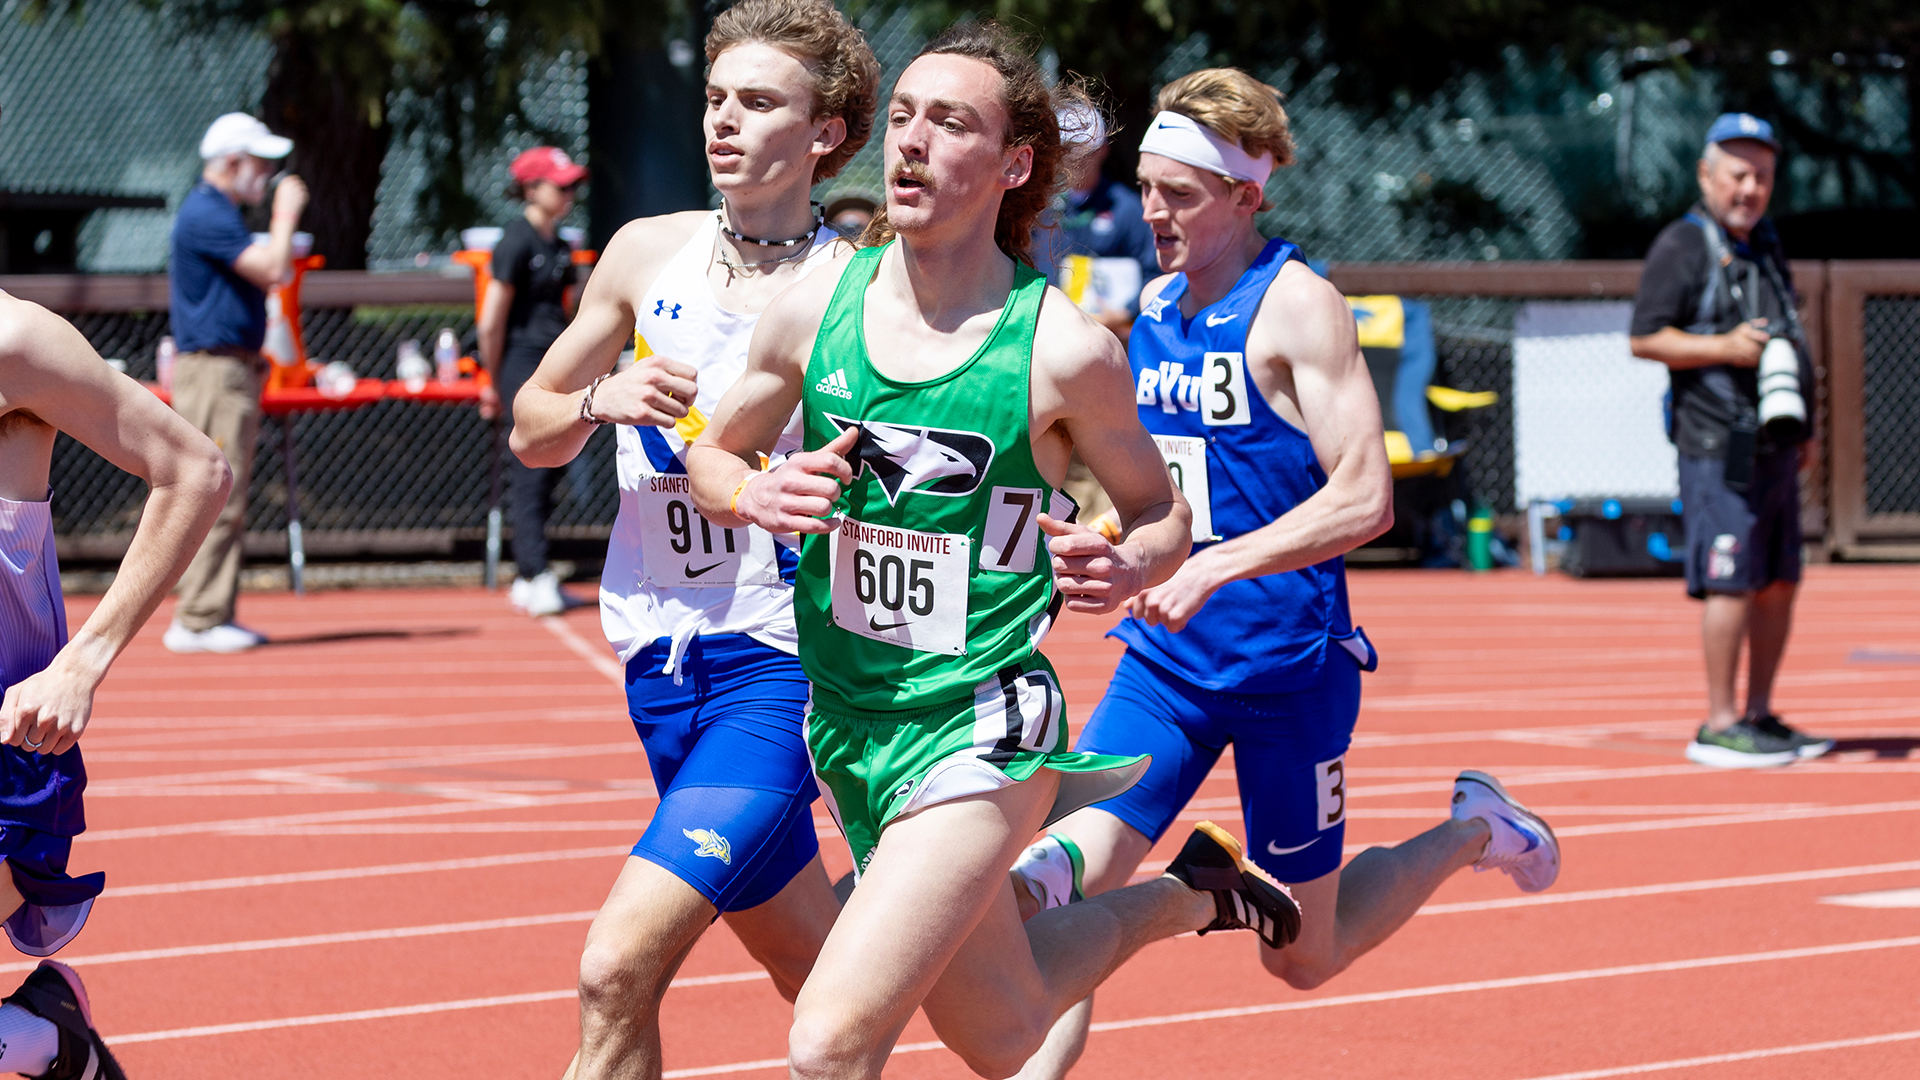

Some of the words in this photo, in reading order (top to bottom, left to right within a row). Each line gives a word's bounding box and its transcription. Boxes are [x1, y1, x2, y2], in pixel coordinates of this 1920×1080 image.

[815, 383, 853, 400] adidas
[1136, 361, 1203, 415] BYU
[1211, 357, 1236, 420] 3
[1165, 440, 1193, 456] INVITE
[650, 475, 689, 494] STANFO
[842, 519, 904, 549] STANFORD
[907, 533, 952, 555] INVITE
[996, 491, 1035, 567] 7
[853, 548, 935, 617] 605
[1025, 674, 1051, 748] 7
[1327, 760, 1345, 824] 3
